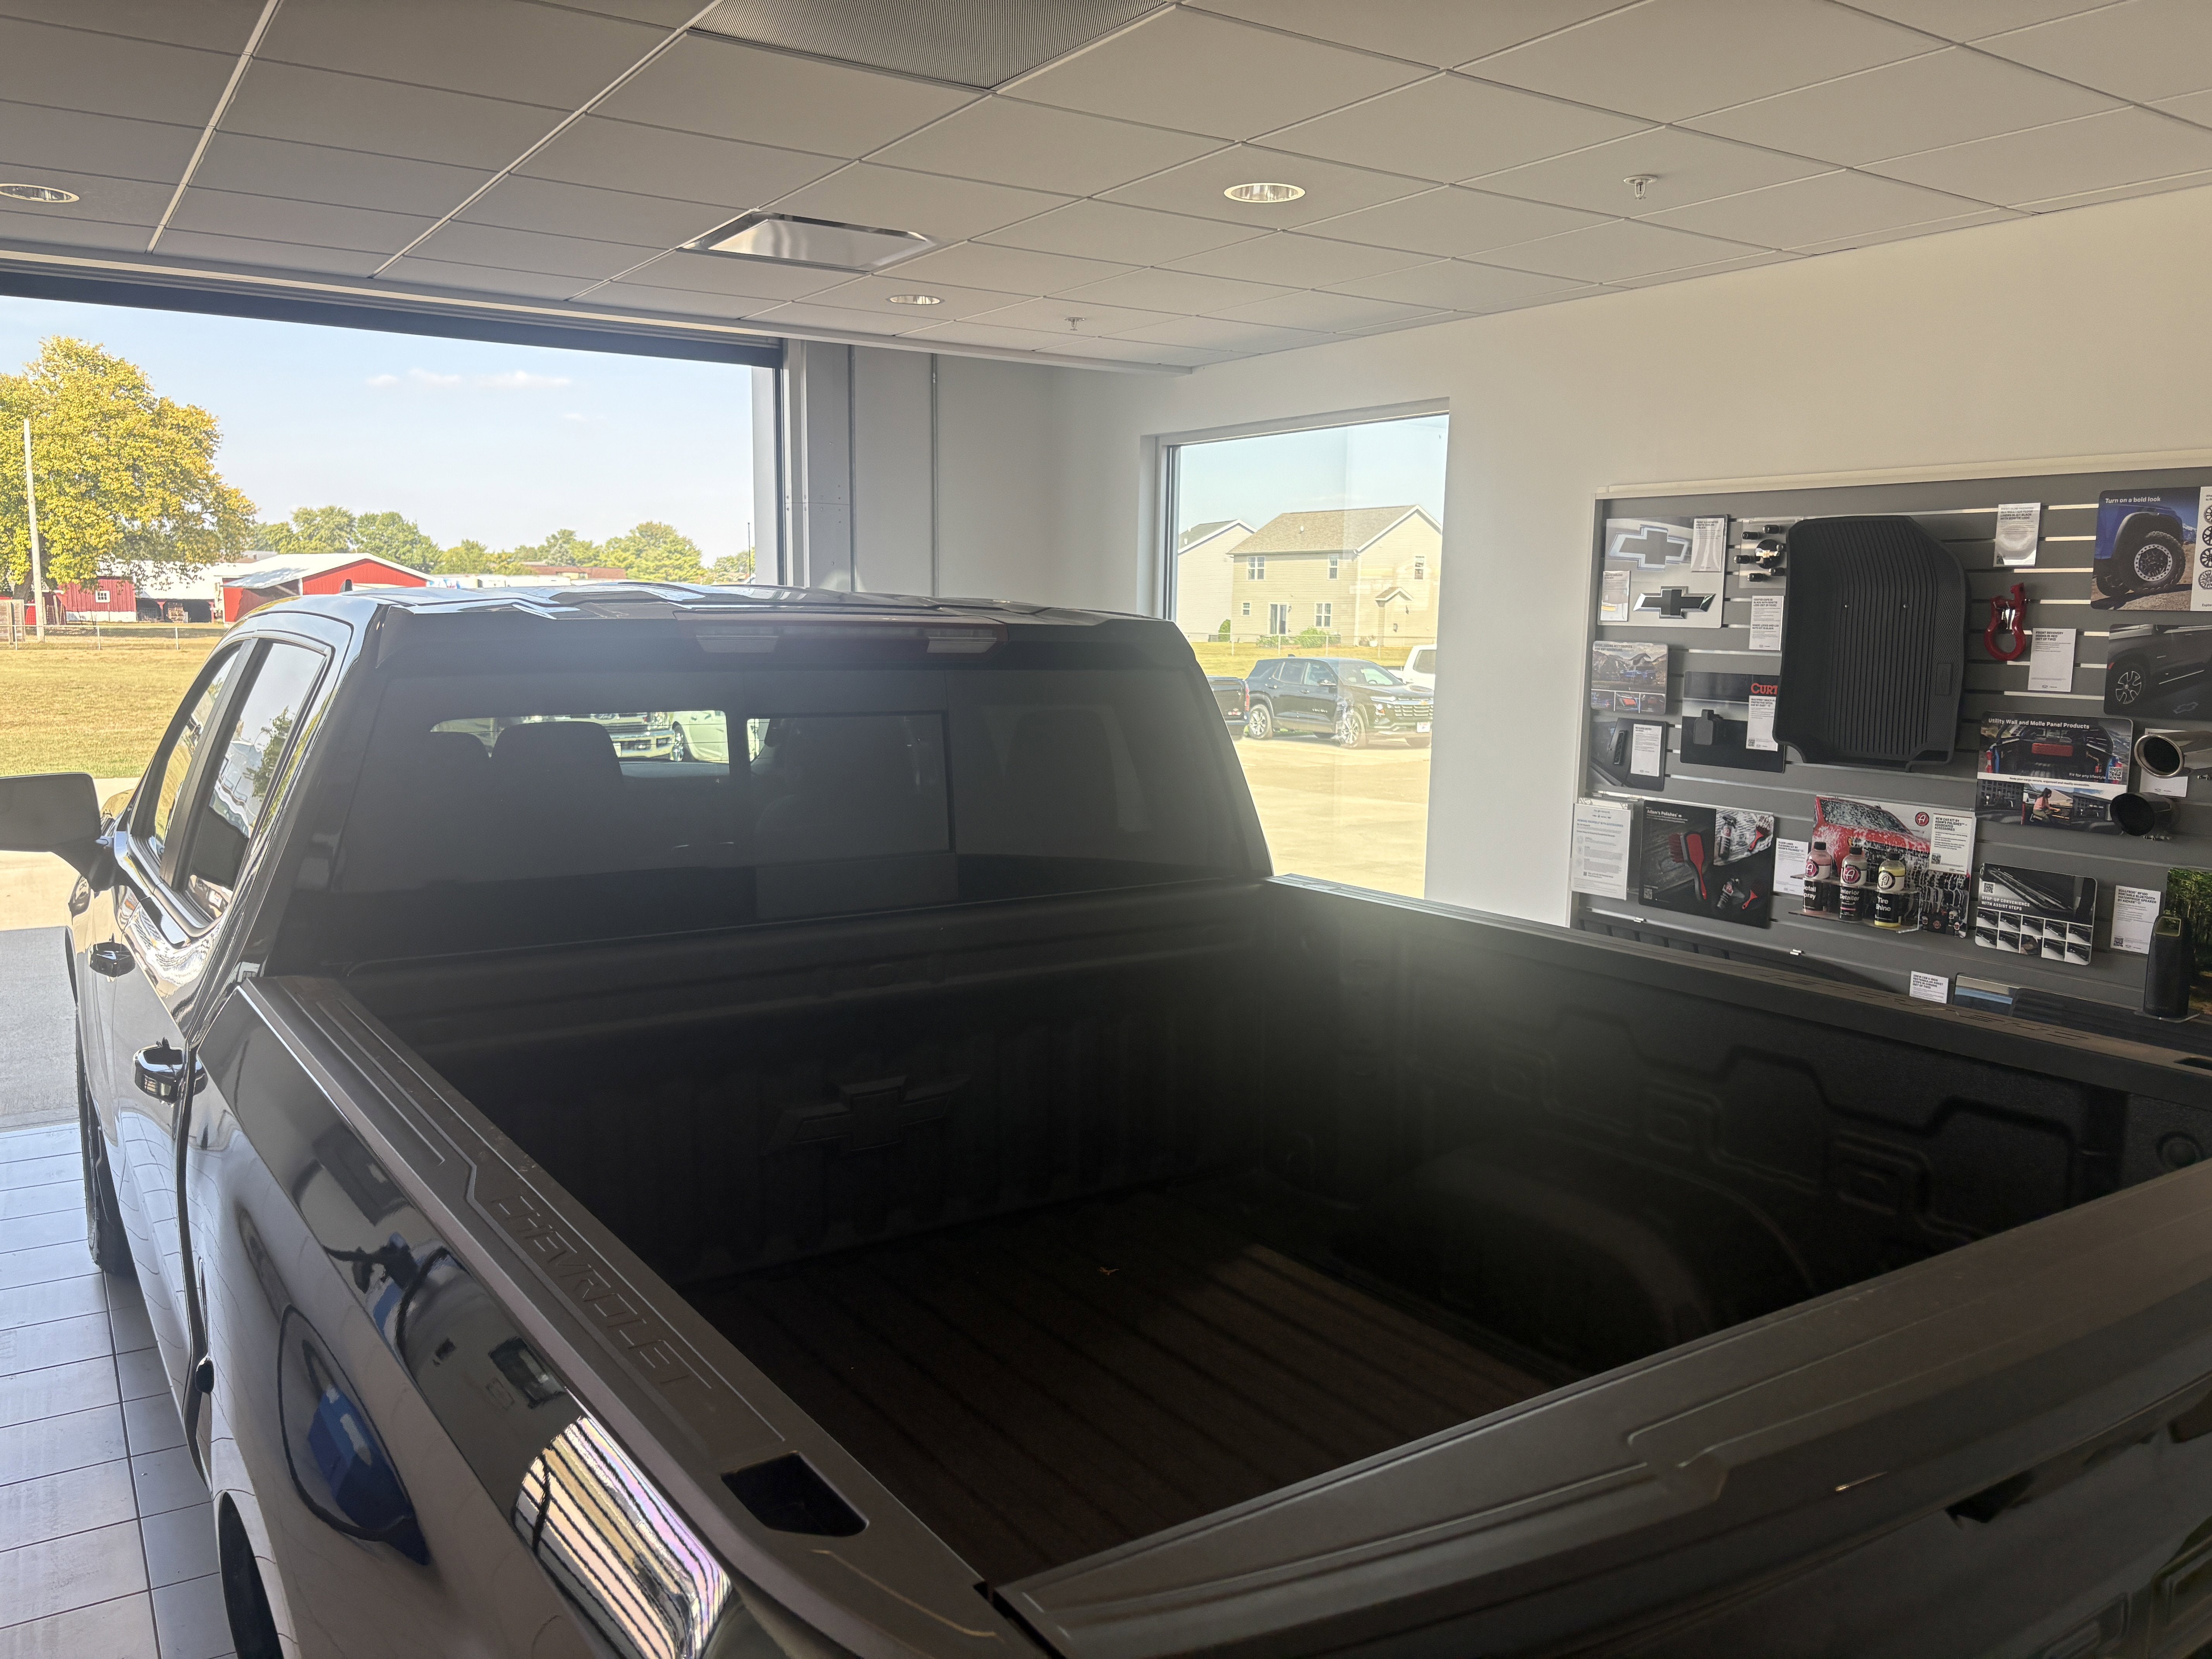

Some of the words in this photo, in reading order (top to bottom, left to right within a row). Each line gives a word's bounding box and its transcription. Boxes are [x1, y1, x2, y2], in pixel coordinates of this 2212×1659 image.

[1751, 683, 1778, 694] CURT
[1840, 887, 1860, 895] Interior
[1877, 896, 1889, 904] Tire
[491, 1195, 712, 1389] CHEVROLET
